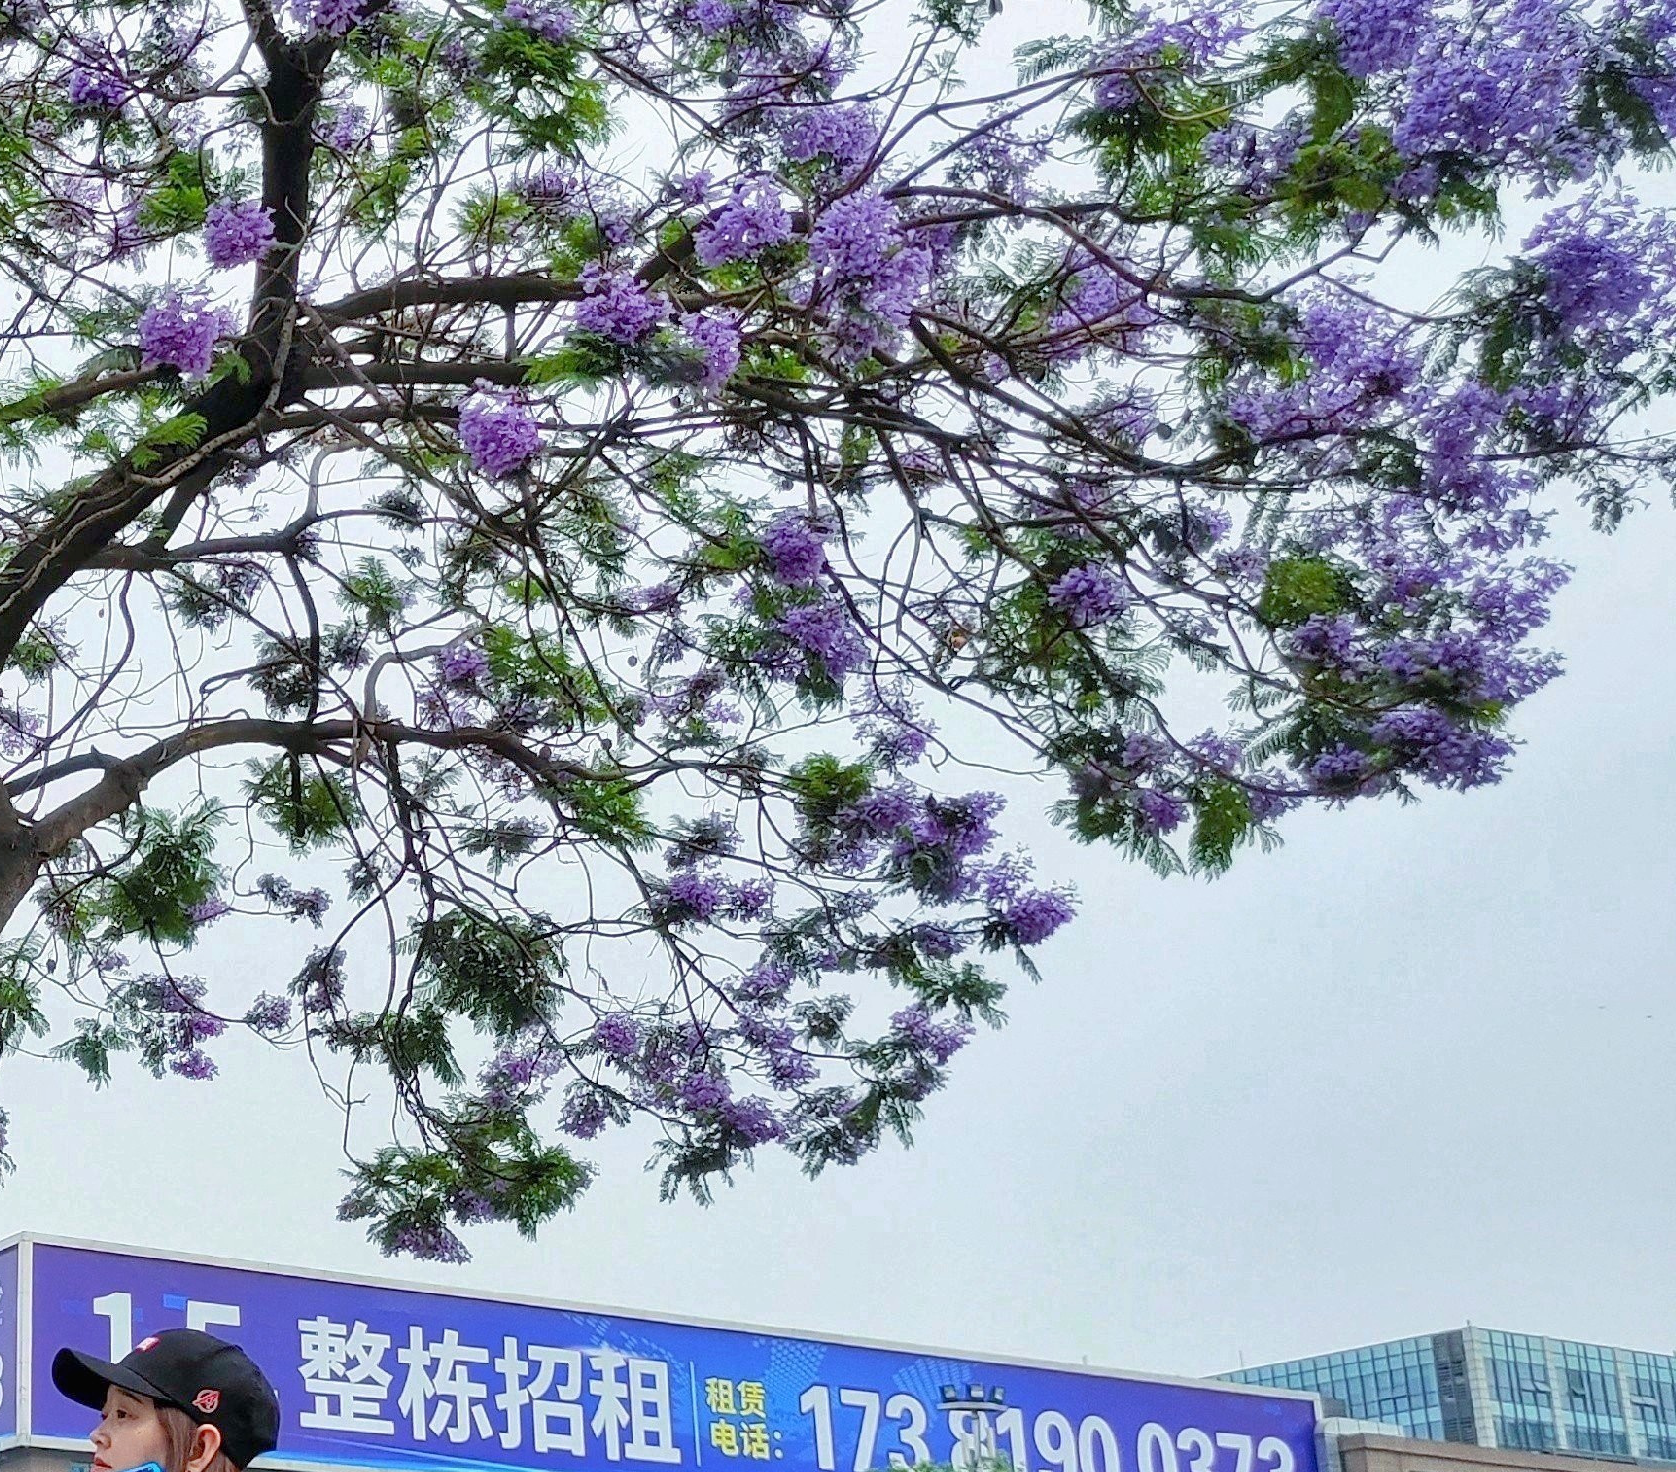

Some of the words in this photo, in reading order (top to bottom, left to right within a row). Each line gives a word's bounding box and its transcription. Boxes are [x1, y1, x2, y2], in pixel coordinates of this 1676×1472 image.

[297, 1315, 681, 1465] 整栋招租
[705, 1377, 767, 1419] 租赁
